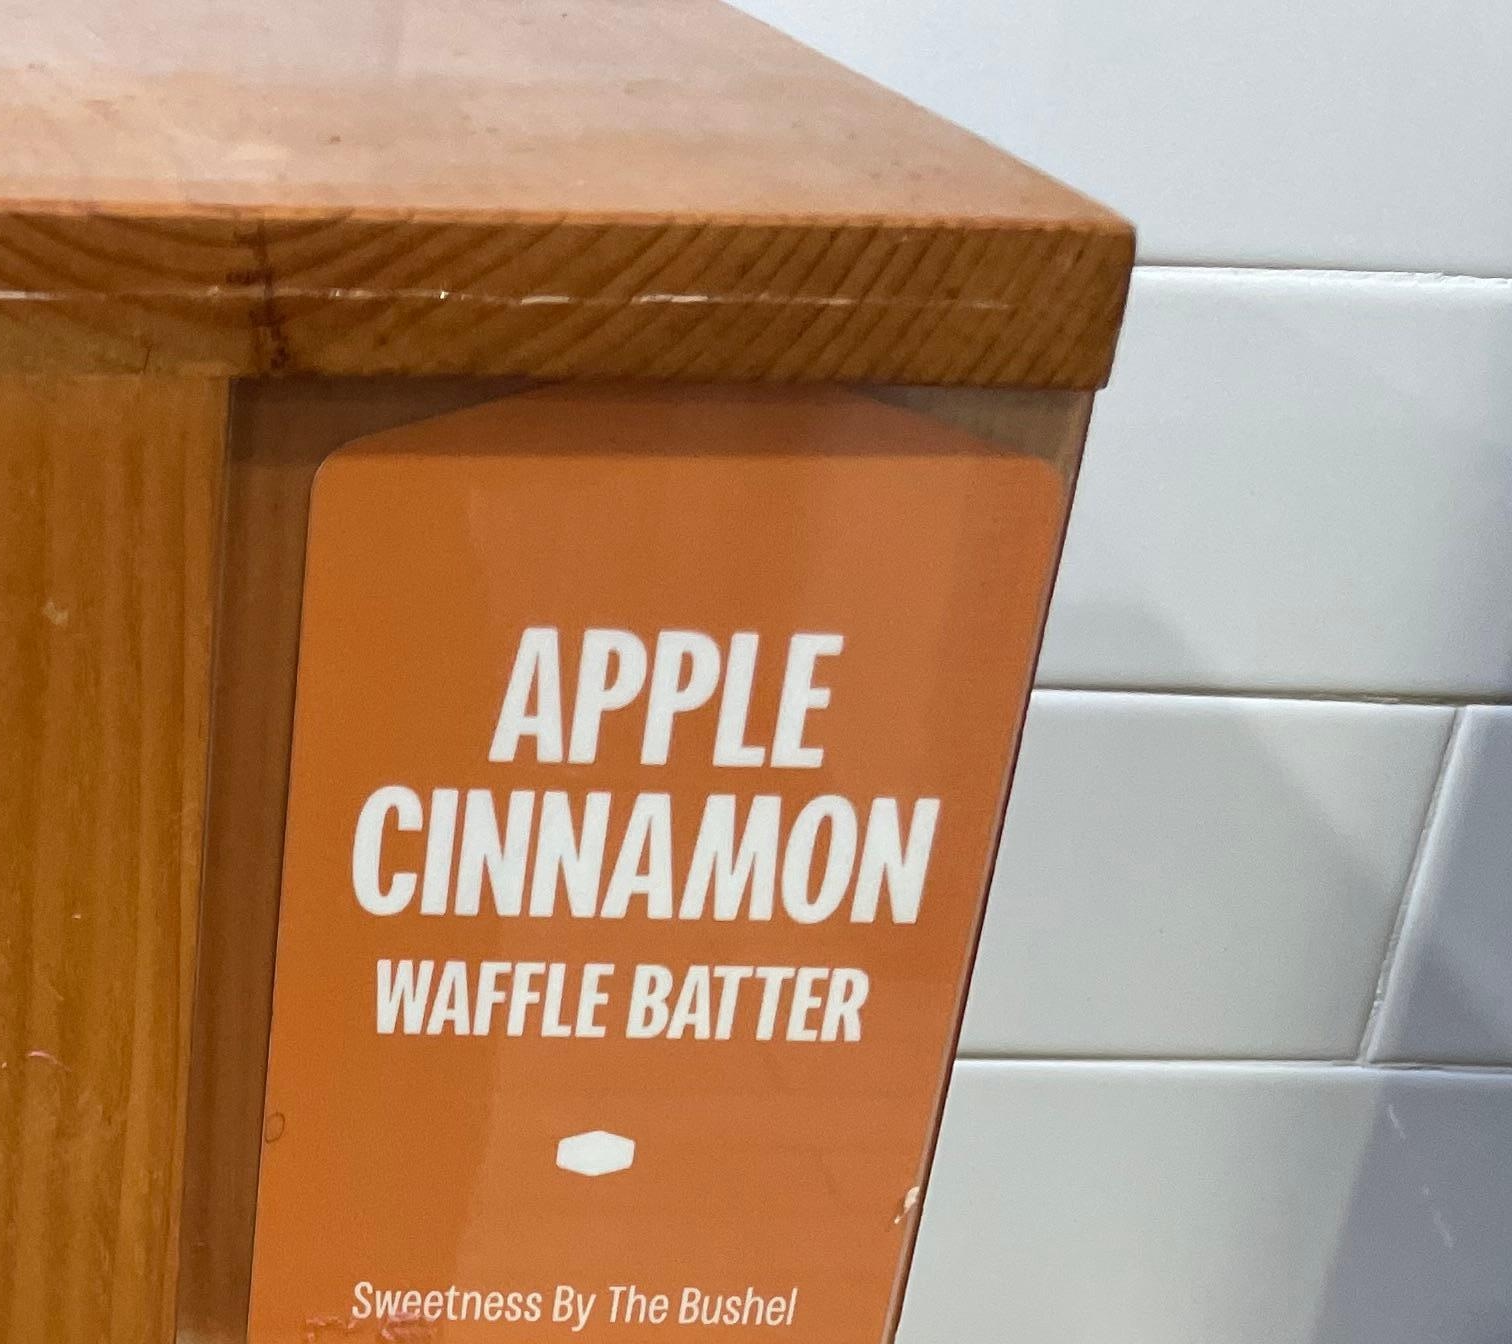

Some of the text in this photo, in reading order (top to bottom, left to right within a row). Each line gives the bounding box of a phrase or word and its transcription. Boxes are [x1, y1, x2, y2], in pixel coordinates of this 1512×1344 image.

[488, 626, 845, 769] APPLE
[352, 784, 941, 925] CINNAMON
[376, 958, 870, 1042] WAFFLE BATTER
[351, 1281, 798, 1332] Sweetness By The Bushel
